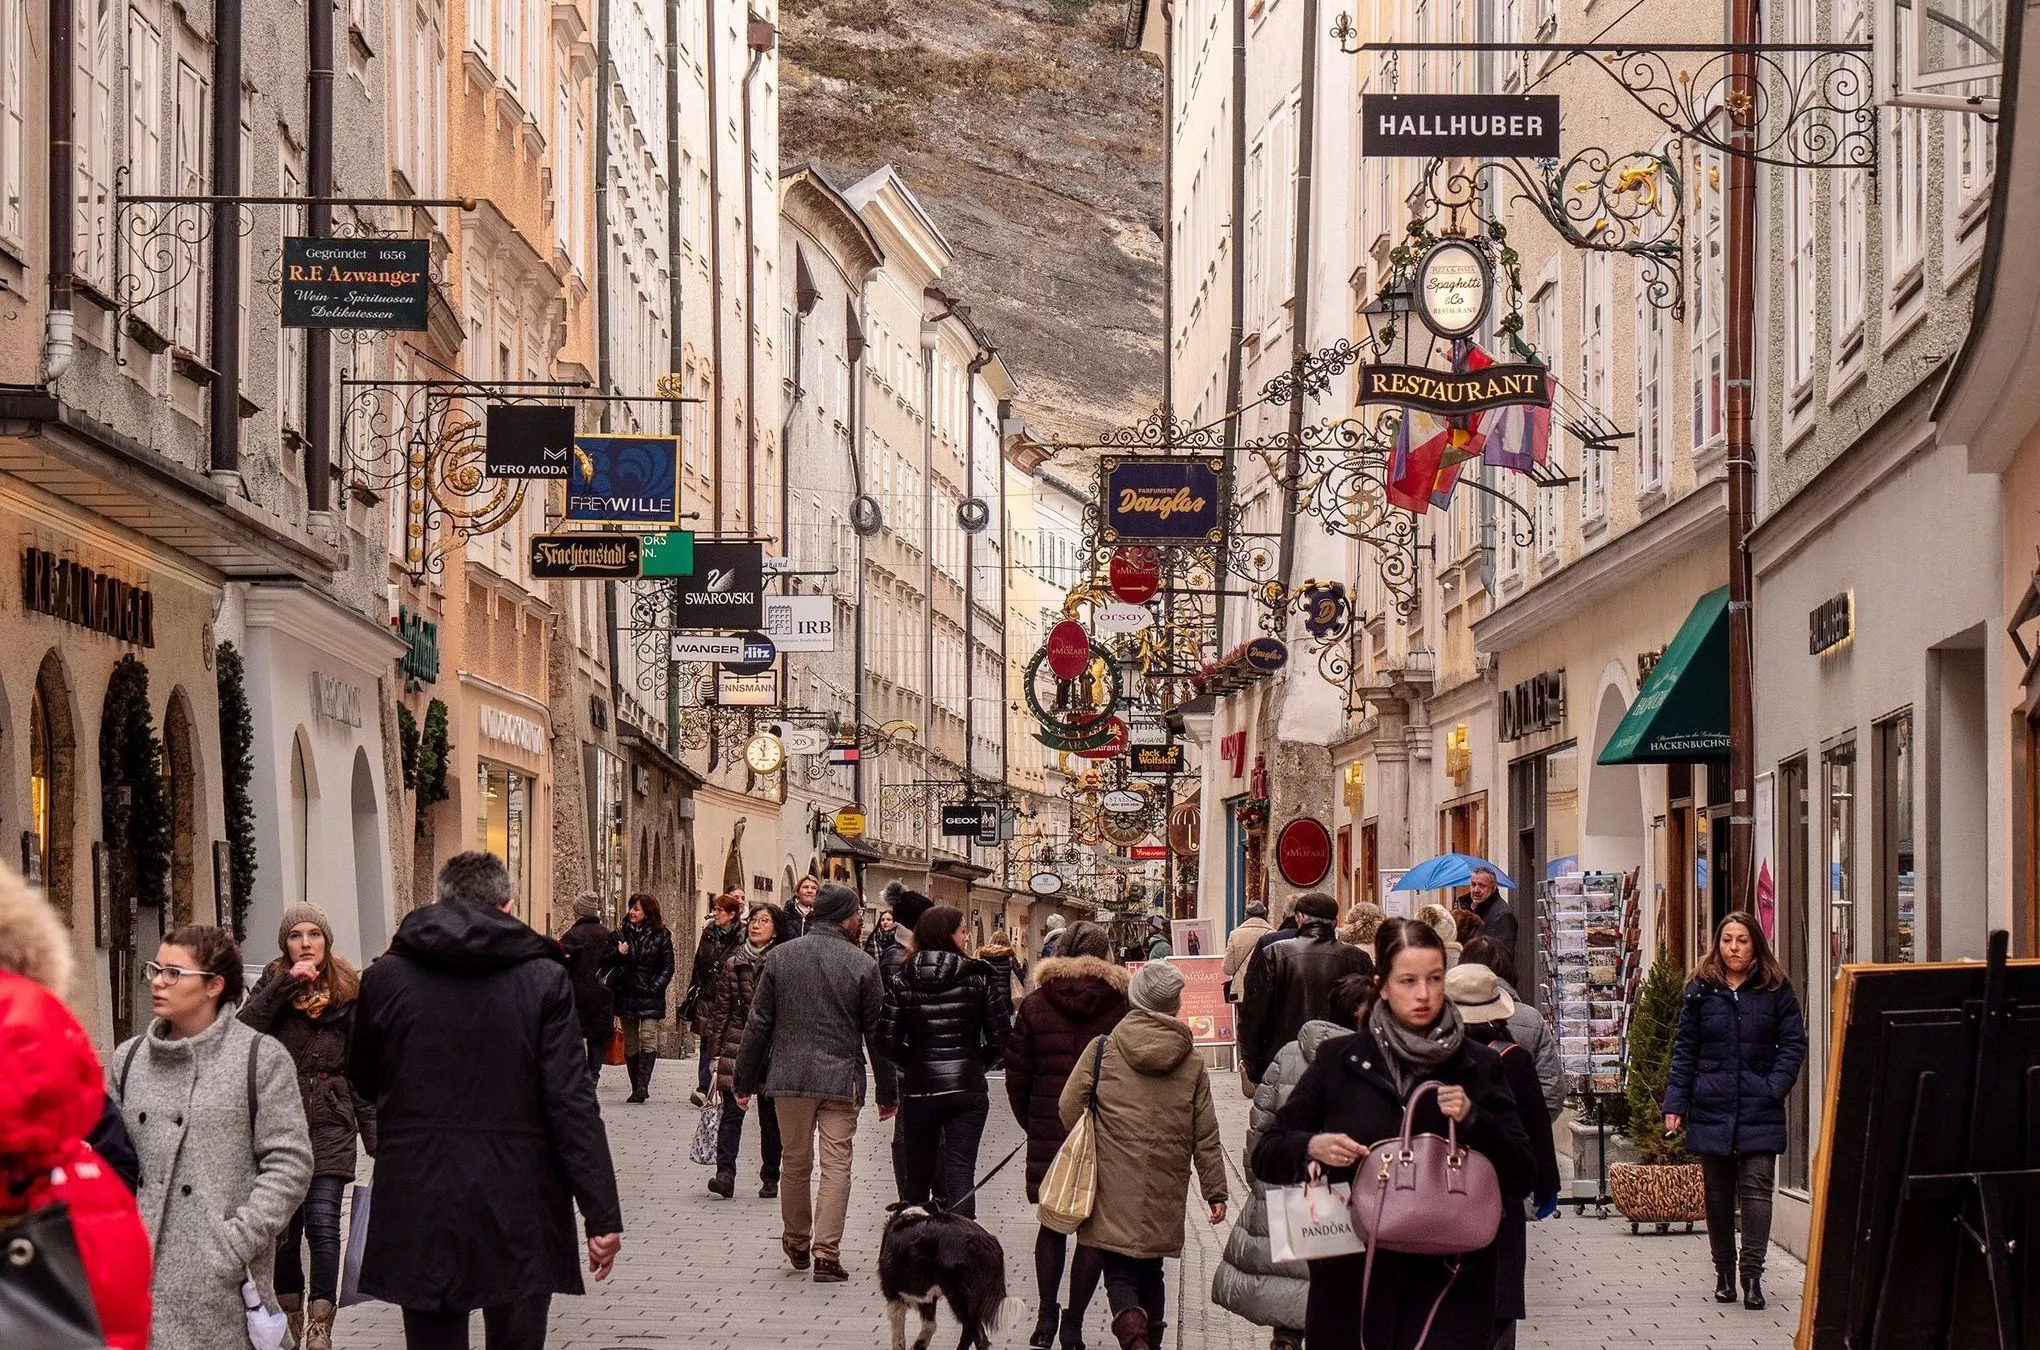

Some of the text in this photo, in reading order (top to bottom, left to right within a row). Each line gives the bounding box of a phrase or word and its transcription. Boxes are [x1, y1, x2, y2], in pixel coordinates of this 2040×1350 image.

[1379, 115, 1543, 136] HALLHUBER
[306, 249, 407, 260] Gegründet 1656
[327, 266, 421, 287] Azwanger
[1426, 277, 1482, 293] Spaghetti
[294, 289, 330, 302] Wein
[344, 290, 417, 305] Spirituosen
[311, 305, 396, 319] Delikatessen
[1372, 373, 1538, 403] RESTAURANT
[490, 465, 568, 475] VERO MODA
[570, 496, 672, 513] FREYWILLE
[1117, 486, 1206, 520] Douglas
[685, 592, 754, 605] SWAROVSKI
[1100, 614, 1146, 626] orsay
[798, 621, 832, 634] IRB
[676, 643, 740, 655] WANGER
[1138, 748, 1161, 757] Jack
[1138, 756, 1177, 765] Wolfskin
[945, 817, 979, 825] GEOX
[1184, 972, 1221, 981] MOZART
[1301, 1221, 1352, 1239] PANDORA
